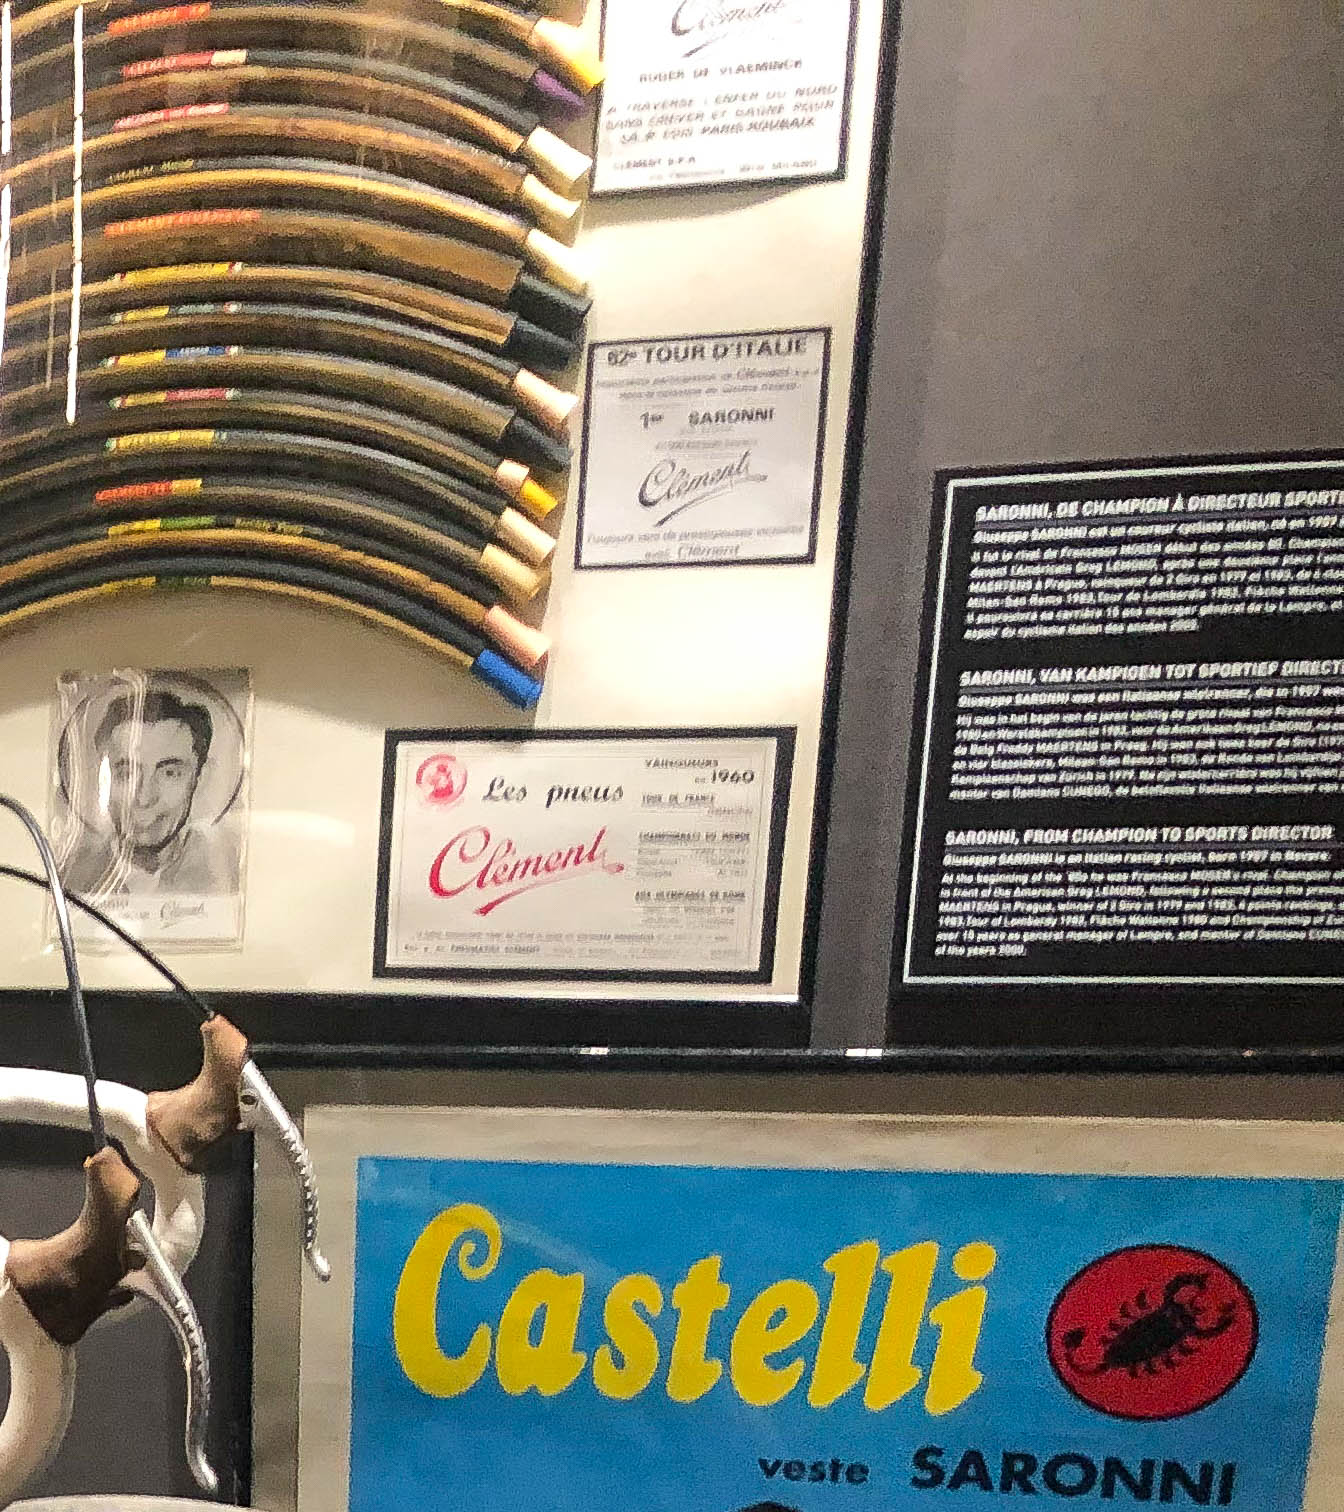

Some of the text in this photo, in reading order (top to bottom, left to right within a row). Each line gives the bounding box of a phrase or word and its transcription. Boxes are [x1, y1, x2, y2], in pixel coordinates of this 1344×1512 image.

[644, 344, 706, 364] TOUR
[711, 337, 809, 361] D'ITALIE
[687, 406, 777, 426] SARONNI
[1081, 497, 1169, 517] CHAMPION
[481, 774, 625, 808] Les pneus
[945, 825, 1333, 845] SARONNI, FROM CHAMPION TO SPORTS DIRECTOR
[393, 1202, 999, 1418] Castelli
[757, 1444, 1238, 1506] veste SARONNI
